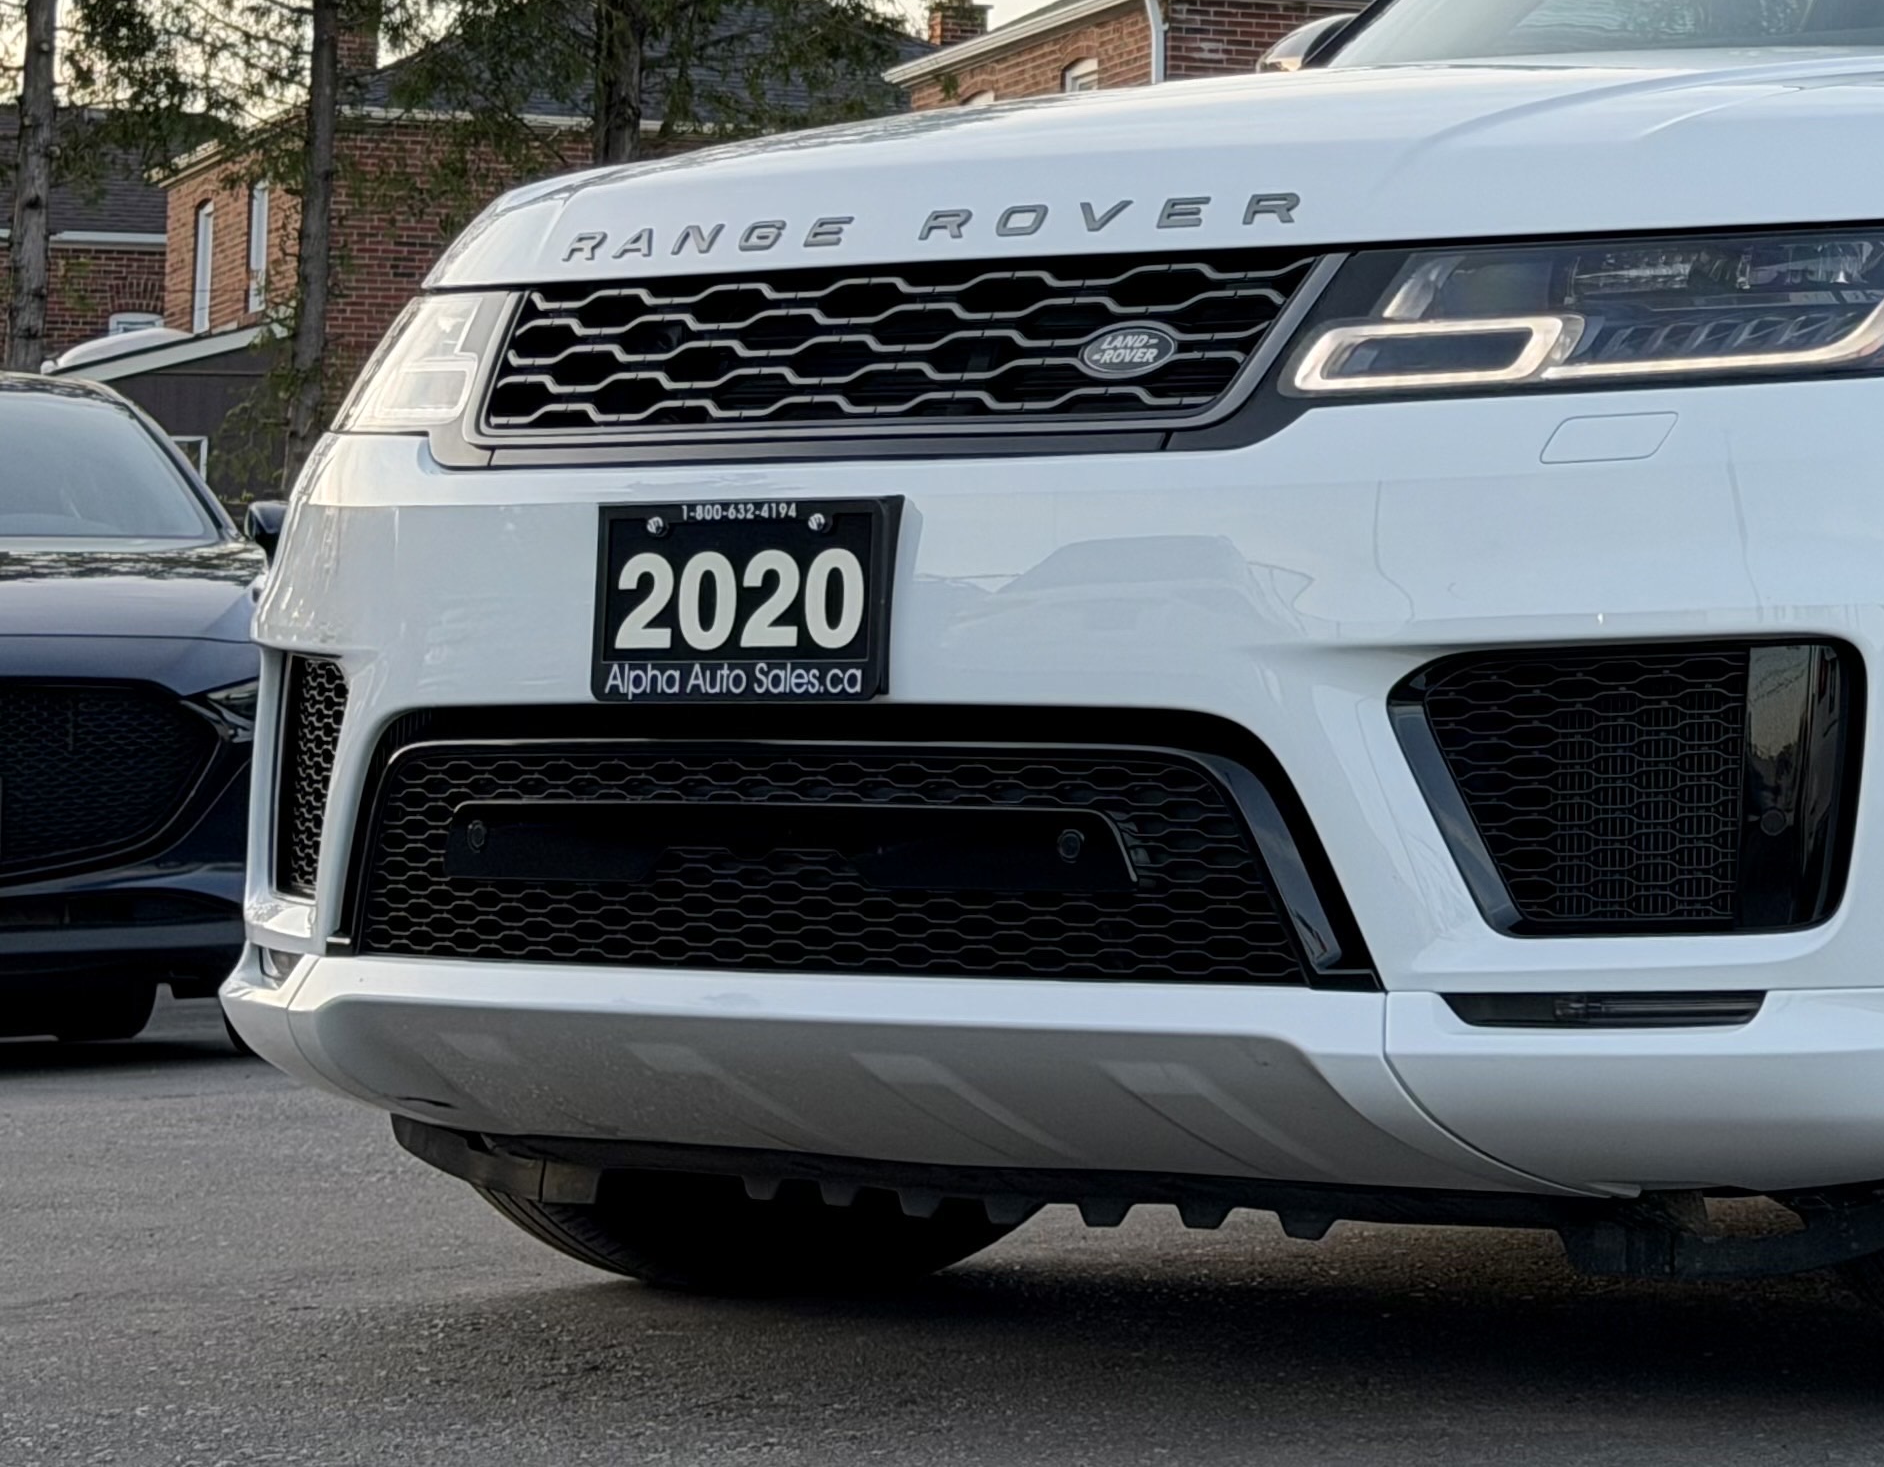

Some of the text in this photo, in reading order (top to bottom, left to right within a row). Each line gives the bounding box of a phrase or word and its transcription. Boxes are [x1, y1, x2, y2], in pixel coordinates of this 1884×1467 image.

[562, 192, 1301, 262] RANGE ROVER
[682, 503, 797, 521] 1-800-632-4194
[614, 548, 864, 651] 2020
[605, 662, 862, 700] Alpha Auto Sales.ca
